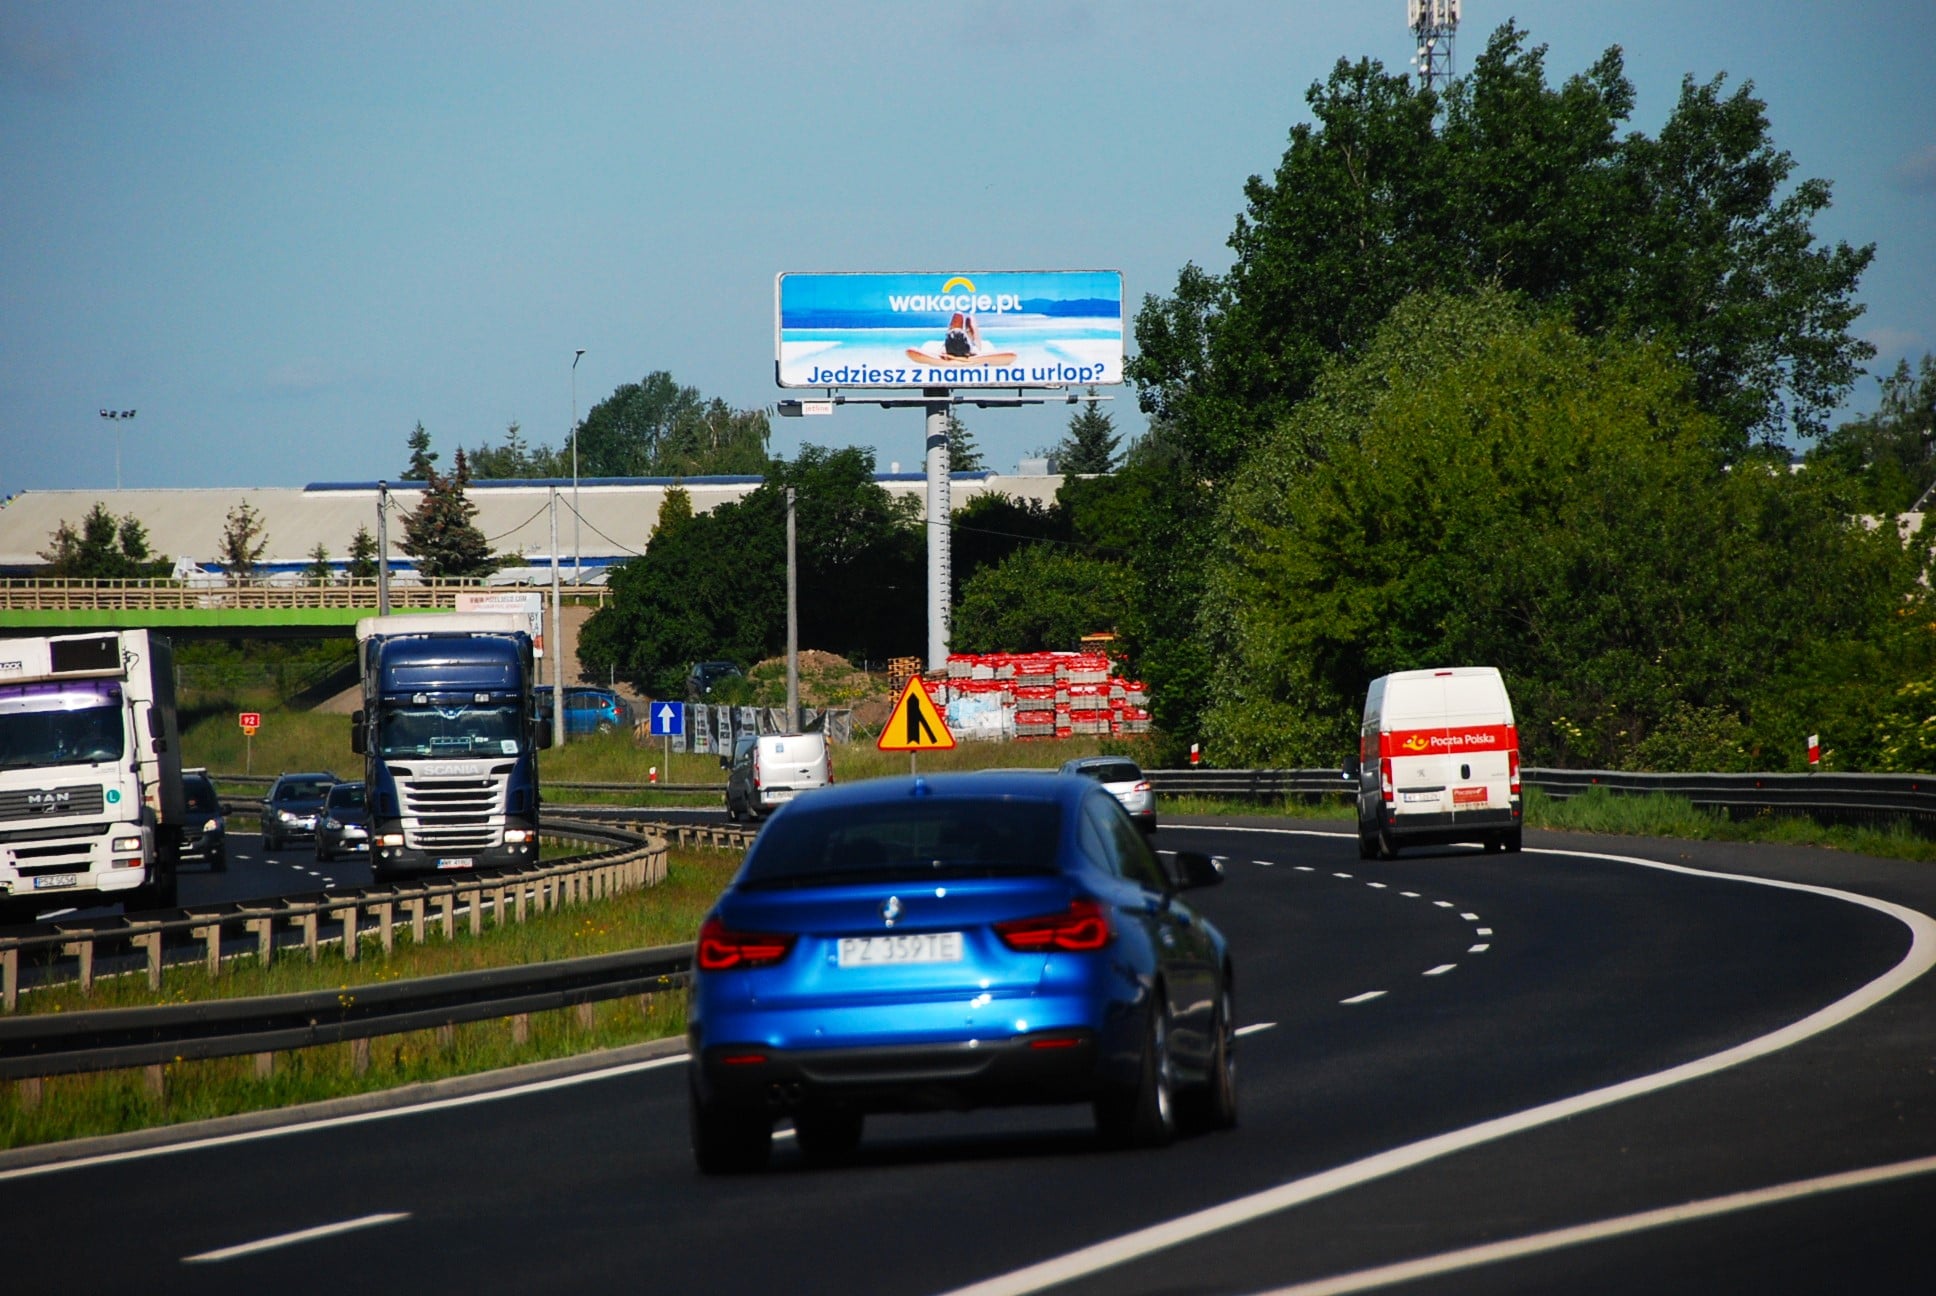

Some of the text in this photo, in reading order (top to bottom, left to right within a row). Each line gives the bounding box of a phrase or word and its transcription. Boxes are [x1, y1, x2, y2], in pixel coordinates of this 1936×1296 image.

[888, 294, 1023, 314] wakacje.pl
[807, 362, 1105, 383] Jedziesz z nami na urlop?
[244, 716, 255, 725] 92
[1430, 733, 1495, 746] Poczta Polska
[423, 763, 479, 776] SCANIA
[28, 792, 70, 804] MAN
[842, 937, 874, 962] PZ
